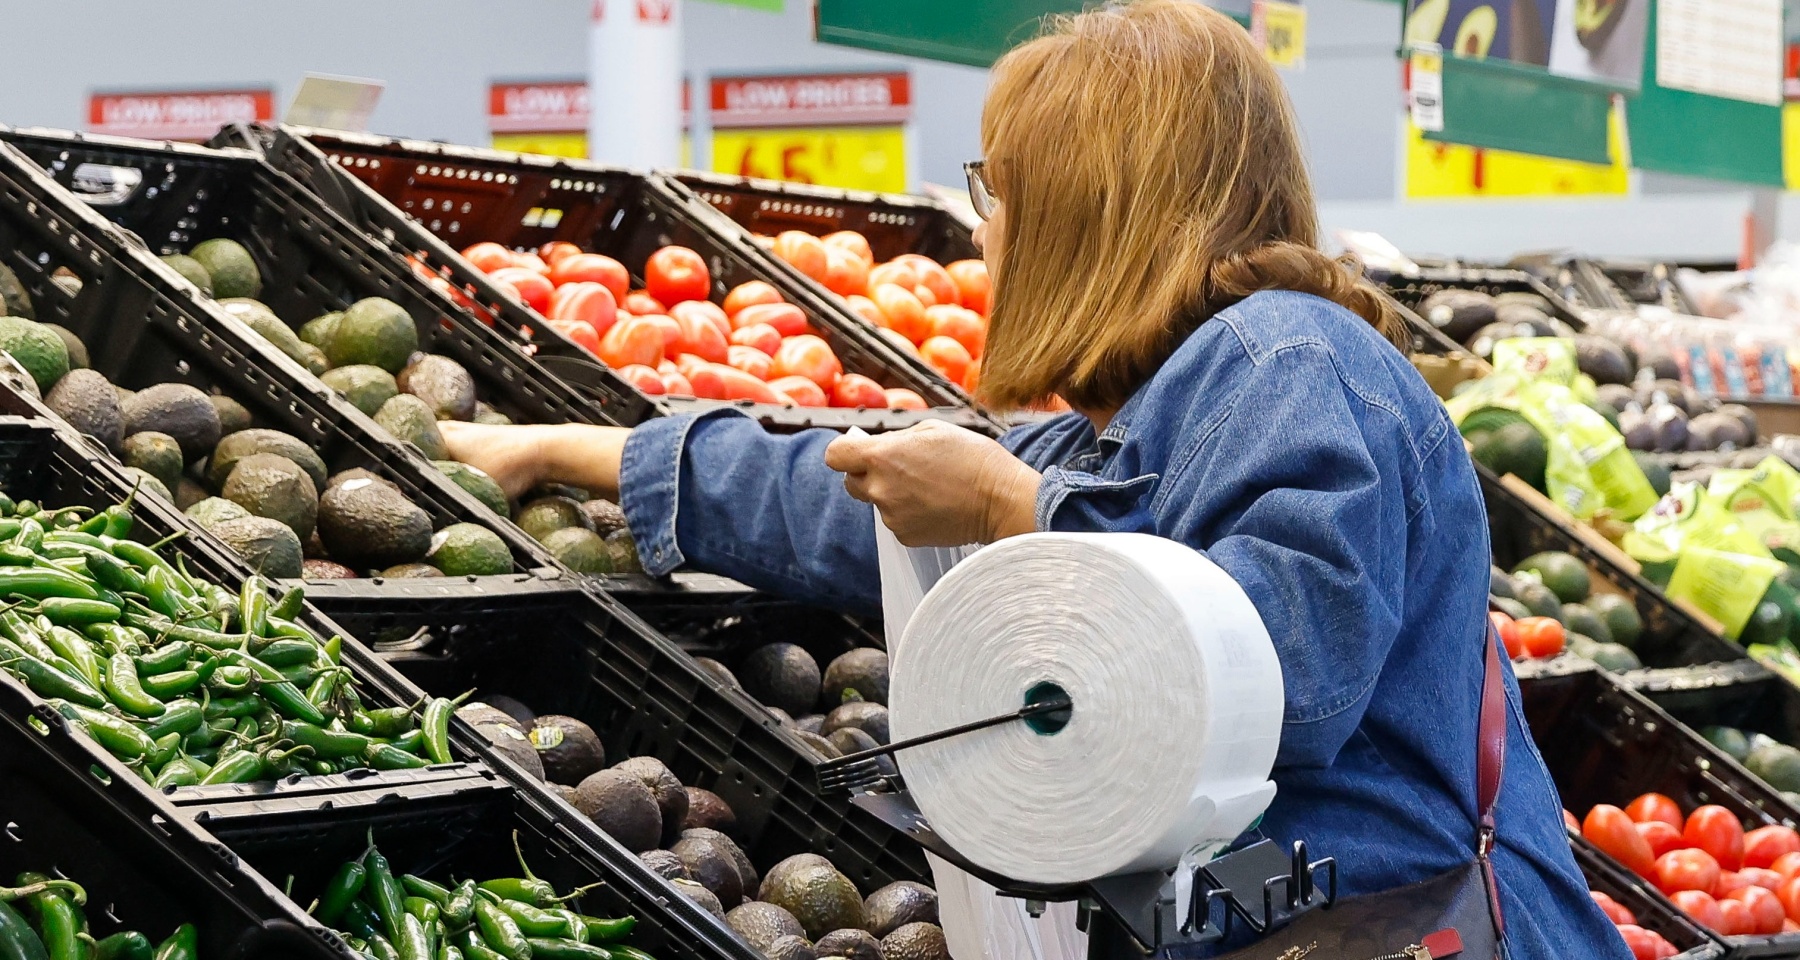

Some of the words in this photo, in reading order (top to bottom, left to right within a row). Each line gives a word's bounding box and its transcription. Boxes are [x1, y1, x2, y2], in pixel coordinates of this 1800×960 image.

[505, 88, 565, 114] LOW
[727, 81, 788, 109] LOW
[796, 78, 890, 107] PRICES
